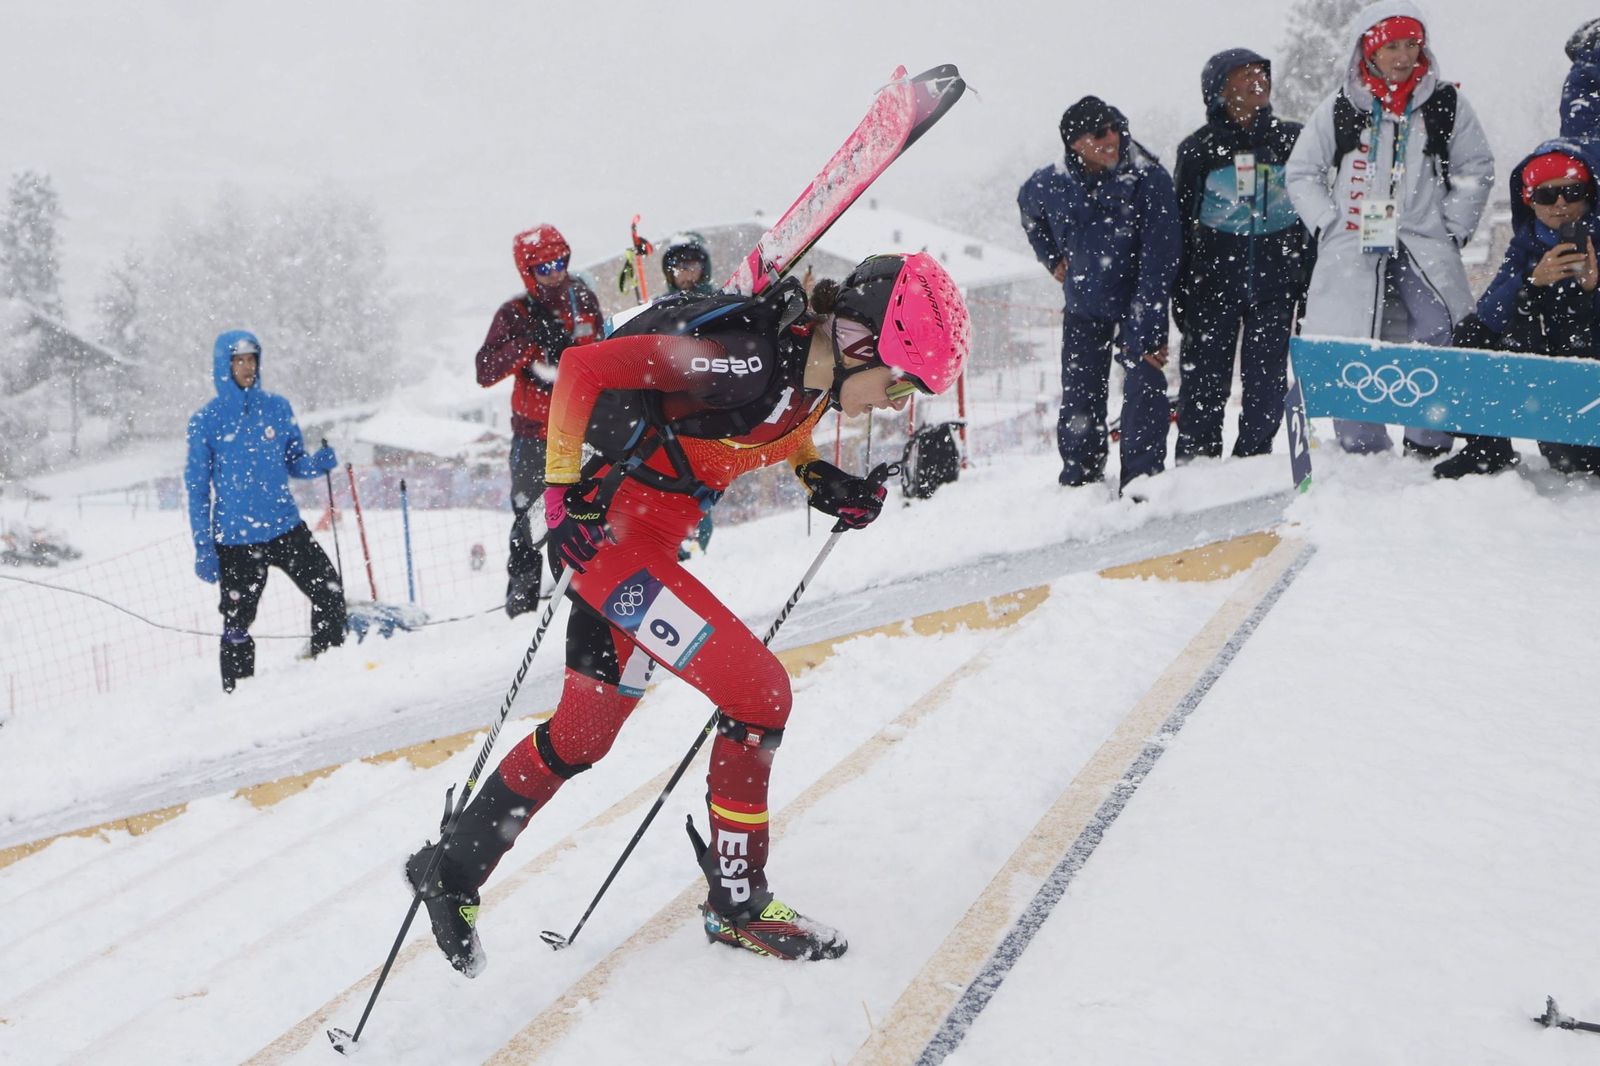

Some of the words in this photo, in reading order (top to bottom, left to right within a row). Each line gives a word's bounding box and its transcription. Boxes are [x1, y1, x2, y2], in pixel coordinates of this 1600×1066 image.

[1345, 143, 1370, 231] POLSKA
[916, 274, 944, 331] DYNAFIT
[499, 604, 555, 724] DYNAFIT
[649, 618, 681, 647] 9
[717, 828, 751, 903] ESP
